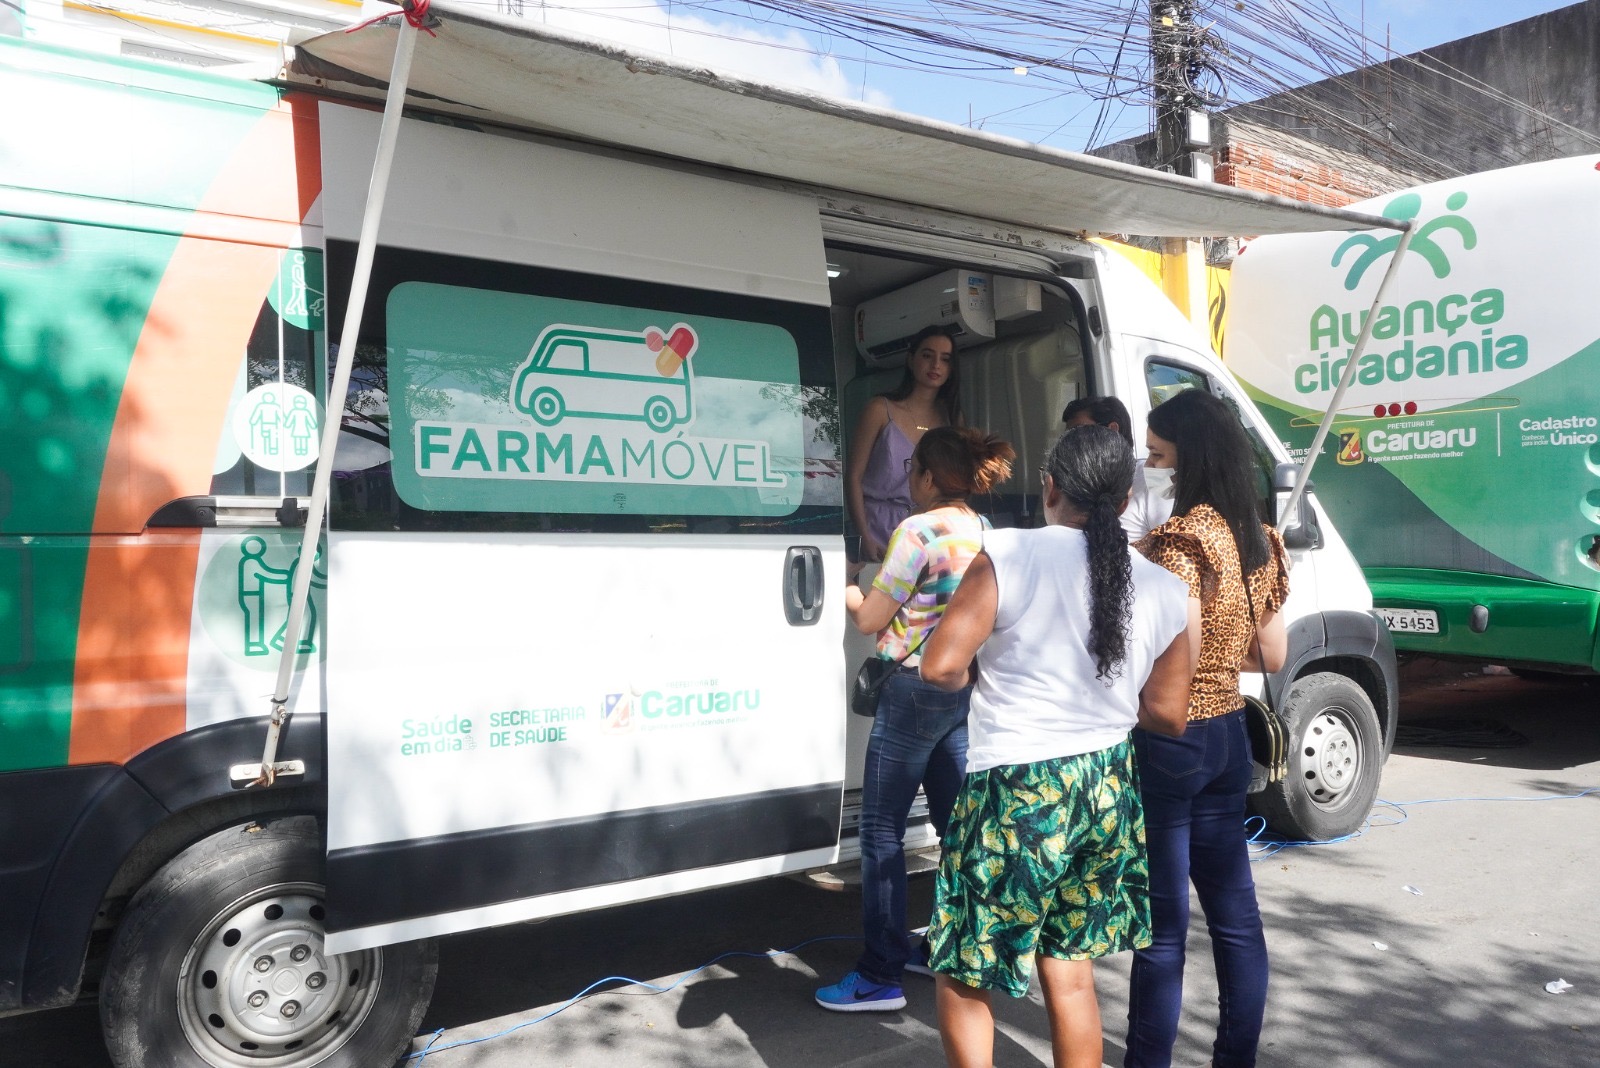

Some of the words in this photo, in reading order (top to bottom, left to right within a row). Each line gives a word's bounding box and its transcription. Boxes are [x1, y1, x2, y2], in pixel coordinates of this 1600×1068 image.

[1310, 288, 1505, 350] Avança
[1294, 328, 1529, 394] cidadania
[1387, 420, 1425, 430] PREFEITURA
[1519, 416, 1598, 432] Cadastro
[1367, 428, 1477, 454] Caruaru
[1550, 430, 1599, 446] Único
[420, 426, 784, 484] FARMAMÓVEL
[1373, 456, 1391, 464] gente
[1413, 452, 1440, 460] fazendo
[1441, 450, 1464, 458] melhor
[640, 687, 761, 720] Caruaru
[401, 713, 473, 740] Saúde
[489, 705, 587, 728] SECRETARIA
[400, 740, 431, 757] em
[434, 736, 463, 753] dia
[489, 731, 511, 748] DE
[515, 725, 568, 746] SAÚDE
